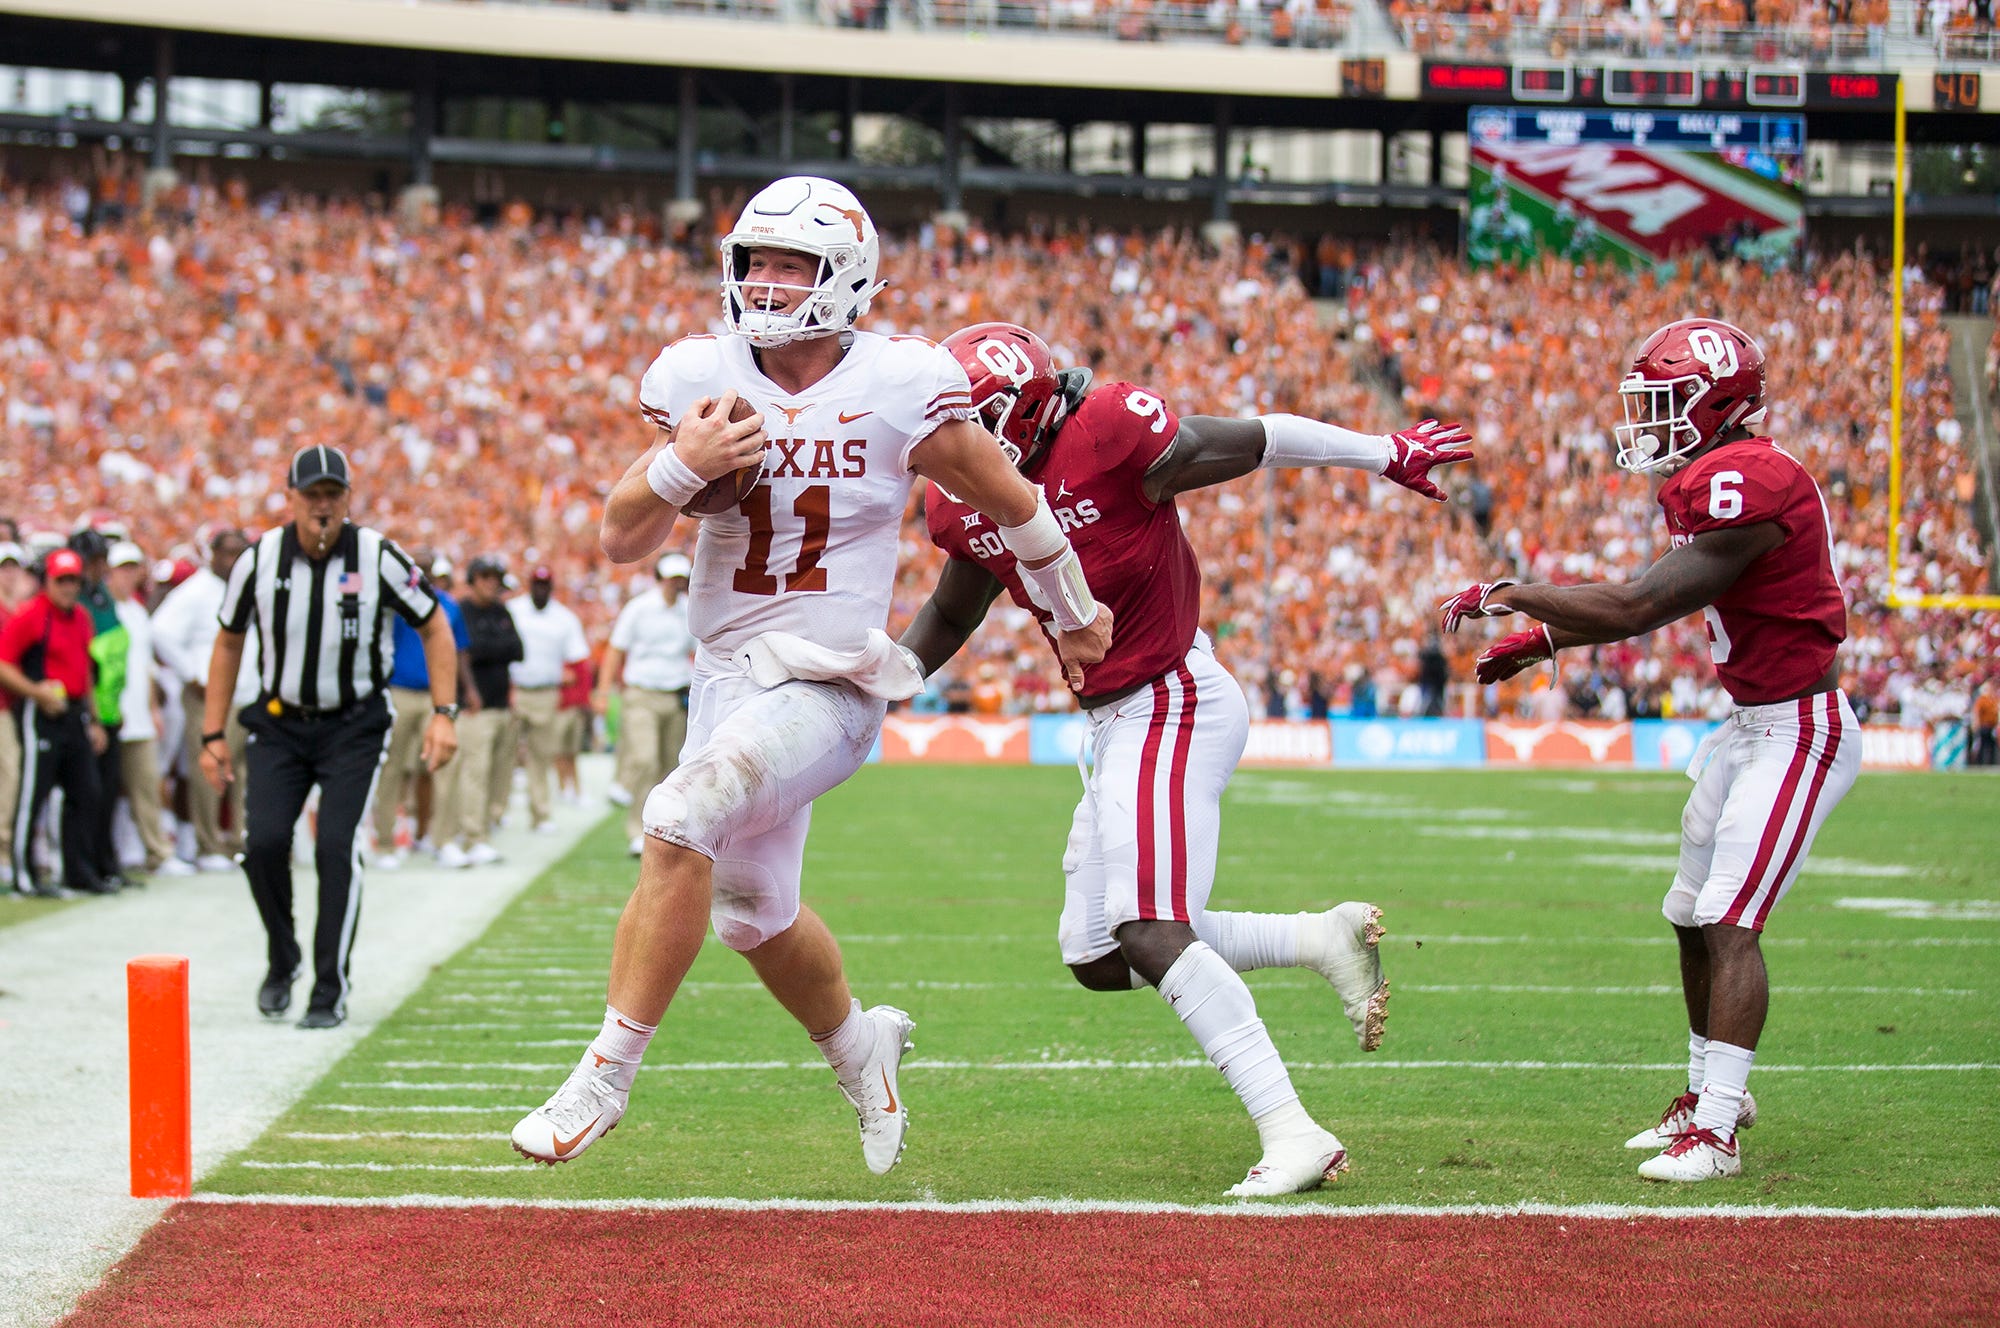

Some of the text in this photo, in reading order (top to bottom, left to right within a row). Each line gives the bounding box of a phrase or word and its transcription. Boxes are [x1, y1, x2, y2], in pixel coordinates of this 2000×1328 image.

[1935, 73, 1979, 107] 40
[976, 339, 1034, 386] OU
[1688, 328, 1740, 378] OU
[1125, 389, 1169, 434] 9
[1708, 470, 1744, 520] 6
[732, 485, 831, 596] 11
[343, 618, 359, 639] H
